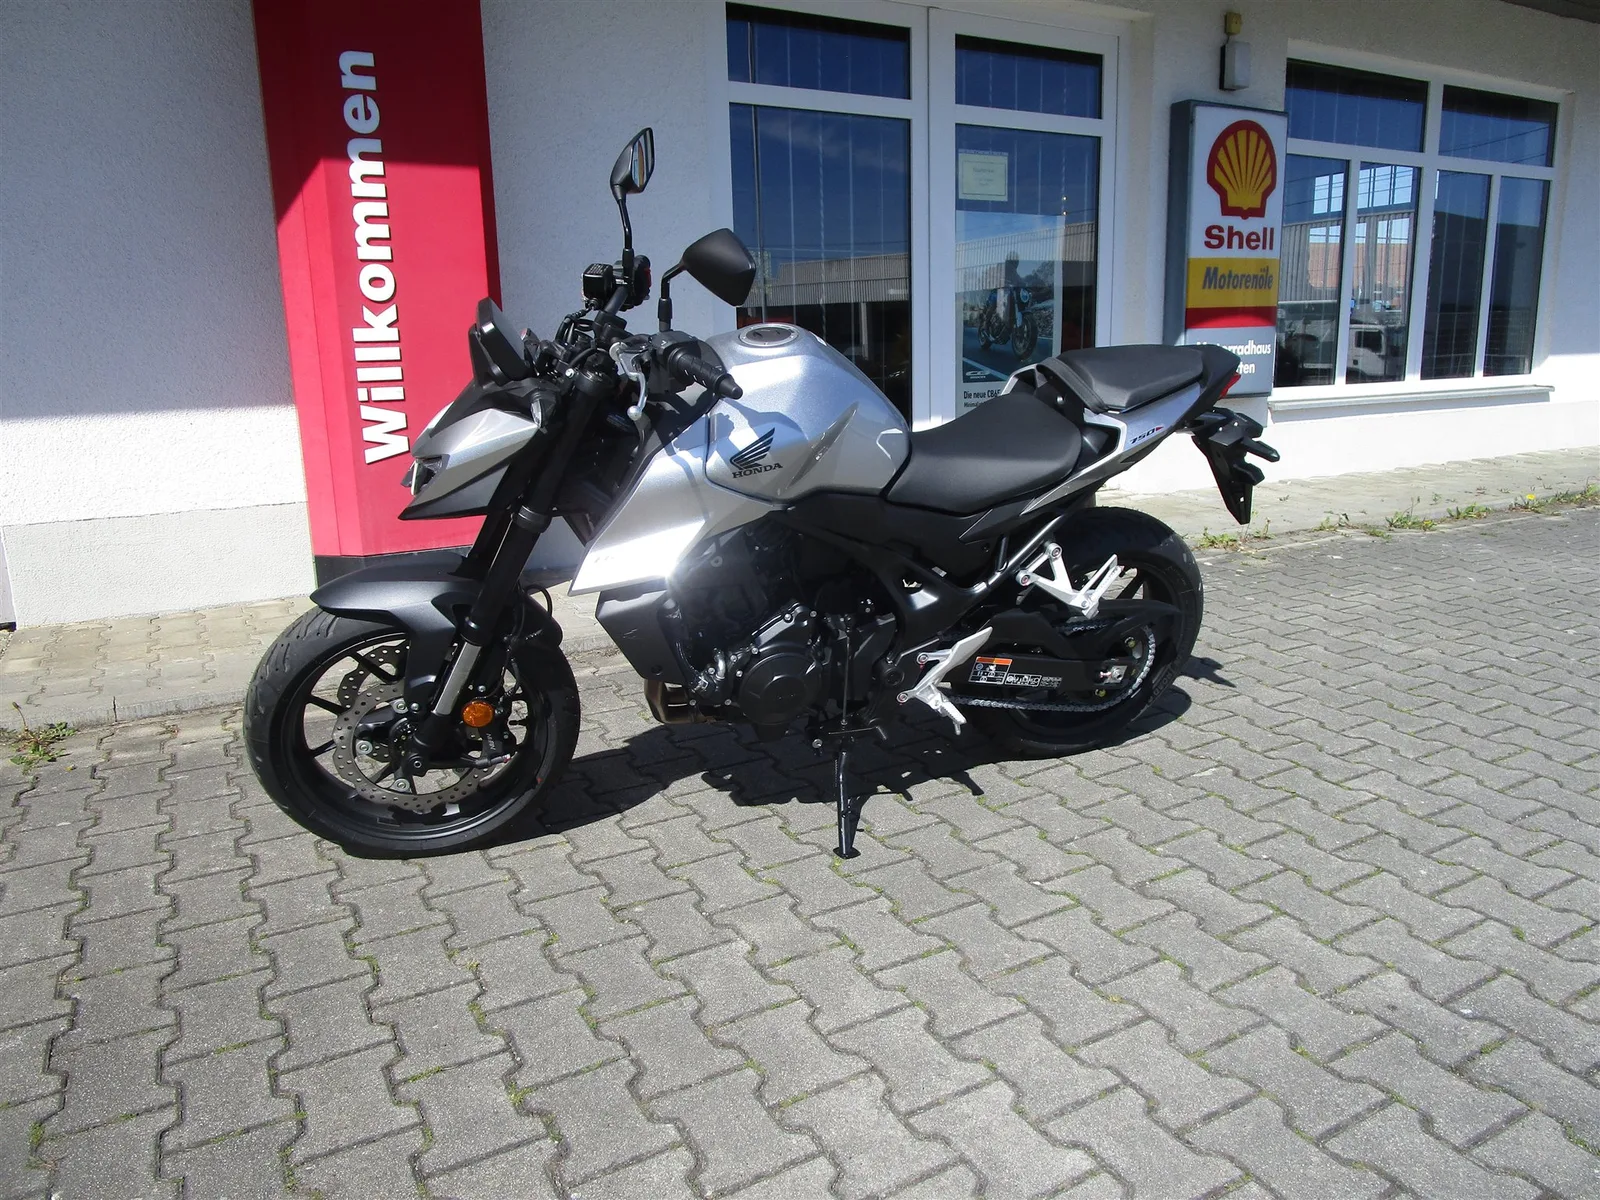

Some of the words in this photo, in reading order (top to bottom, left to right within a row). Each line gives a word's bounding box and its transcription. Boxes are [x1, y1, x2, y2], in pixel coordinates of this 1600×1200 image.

[1204, 224, 1274, 250] Shell
[339, 50, 411, 465] Willkommen
[1203, 266, 1273, 290] Motorenöle
[963, 391, 972, 399] Die
[732, 462, 783, 479] HONDA
